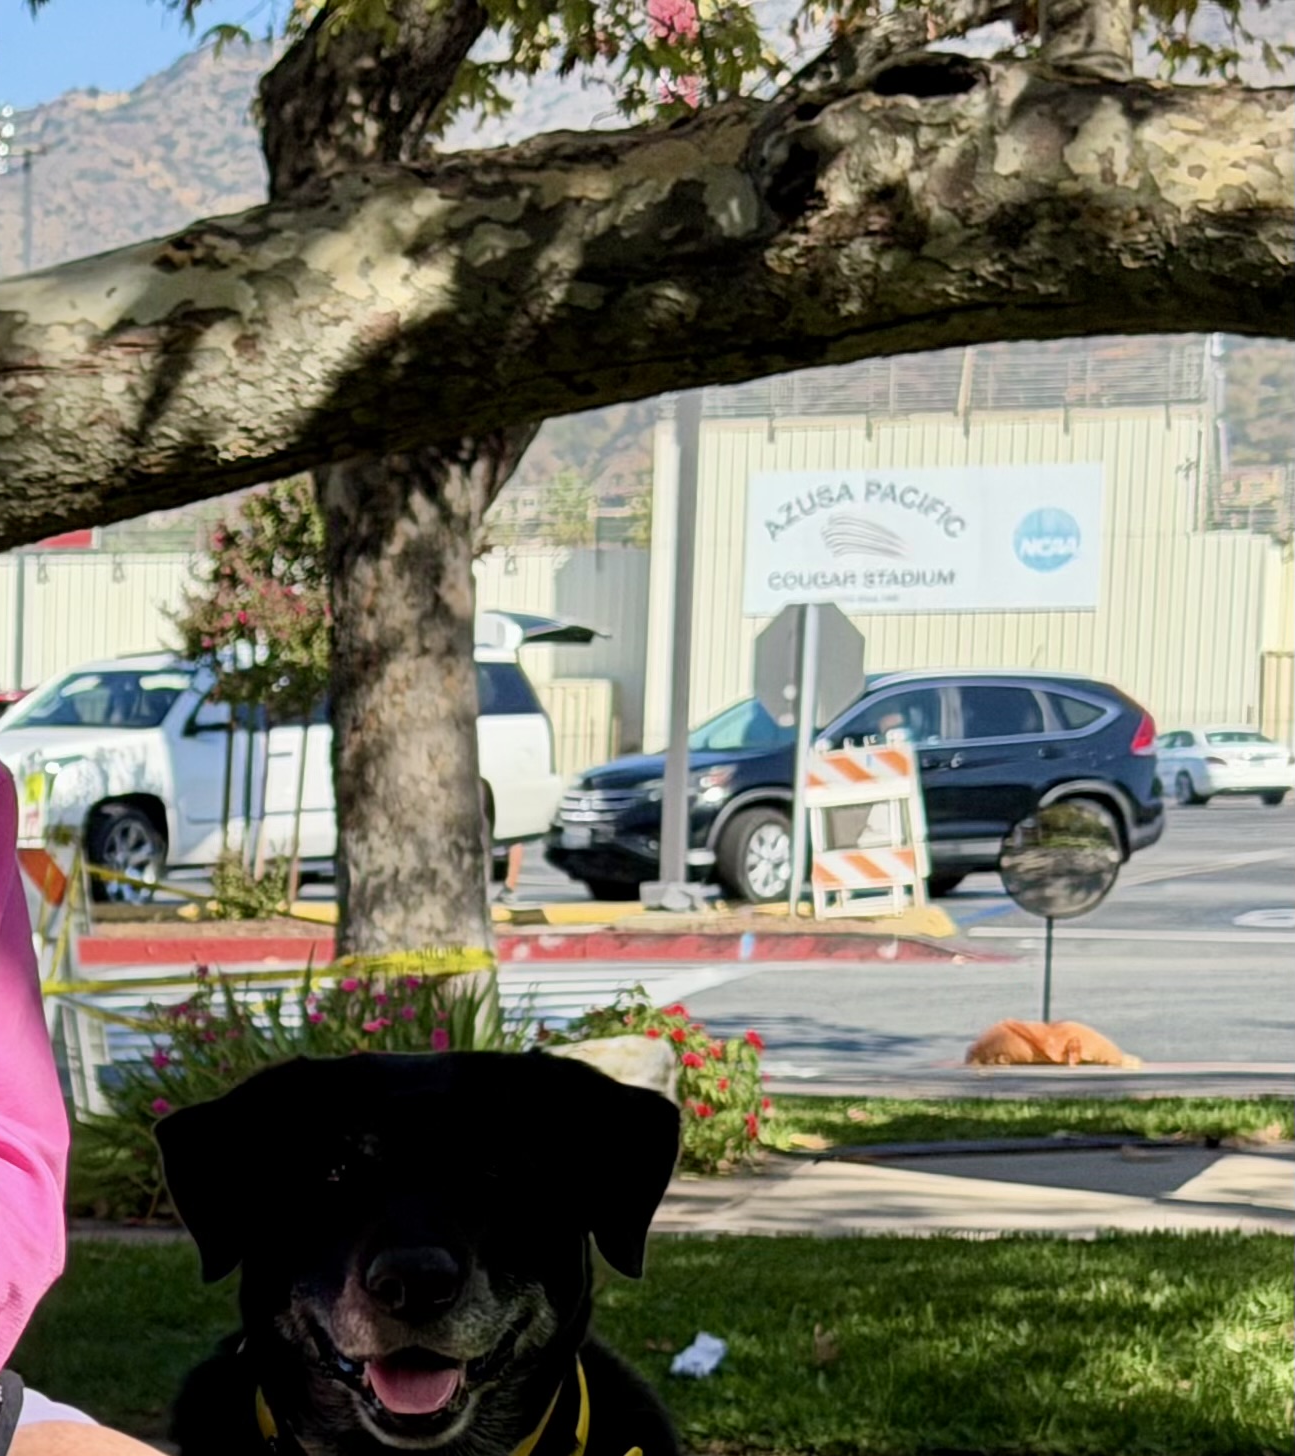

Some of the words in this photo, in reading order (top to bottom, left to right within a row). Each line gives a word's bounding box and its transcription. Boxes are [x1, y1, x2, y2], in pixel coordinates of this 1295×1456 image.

[764, 482, 855, 542] AZUSA
[863, 480, 967, 539] PACIFIC
[767, 571, 857, 590] COUGAR
[863, 569, 956, 589] STADIUM
